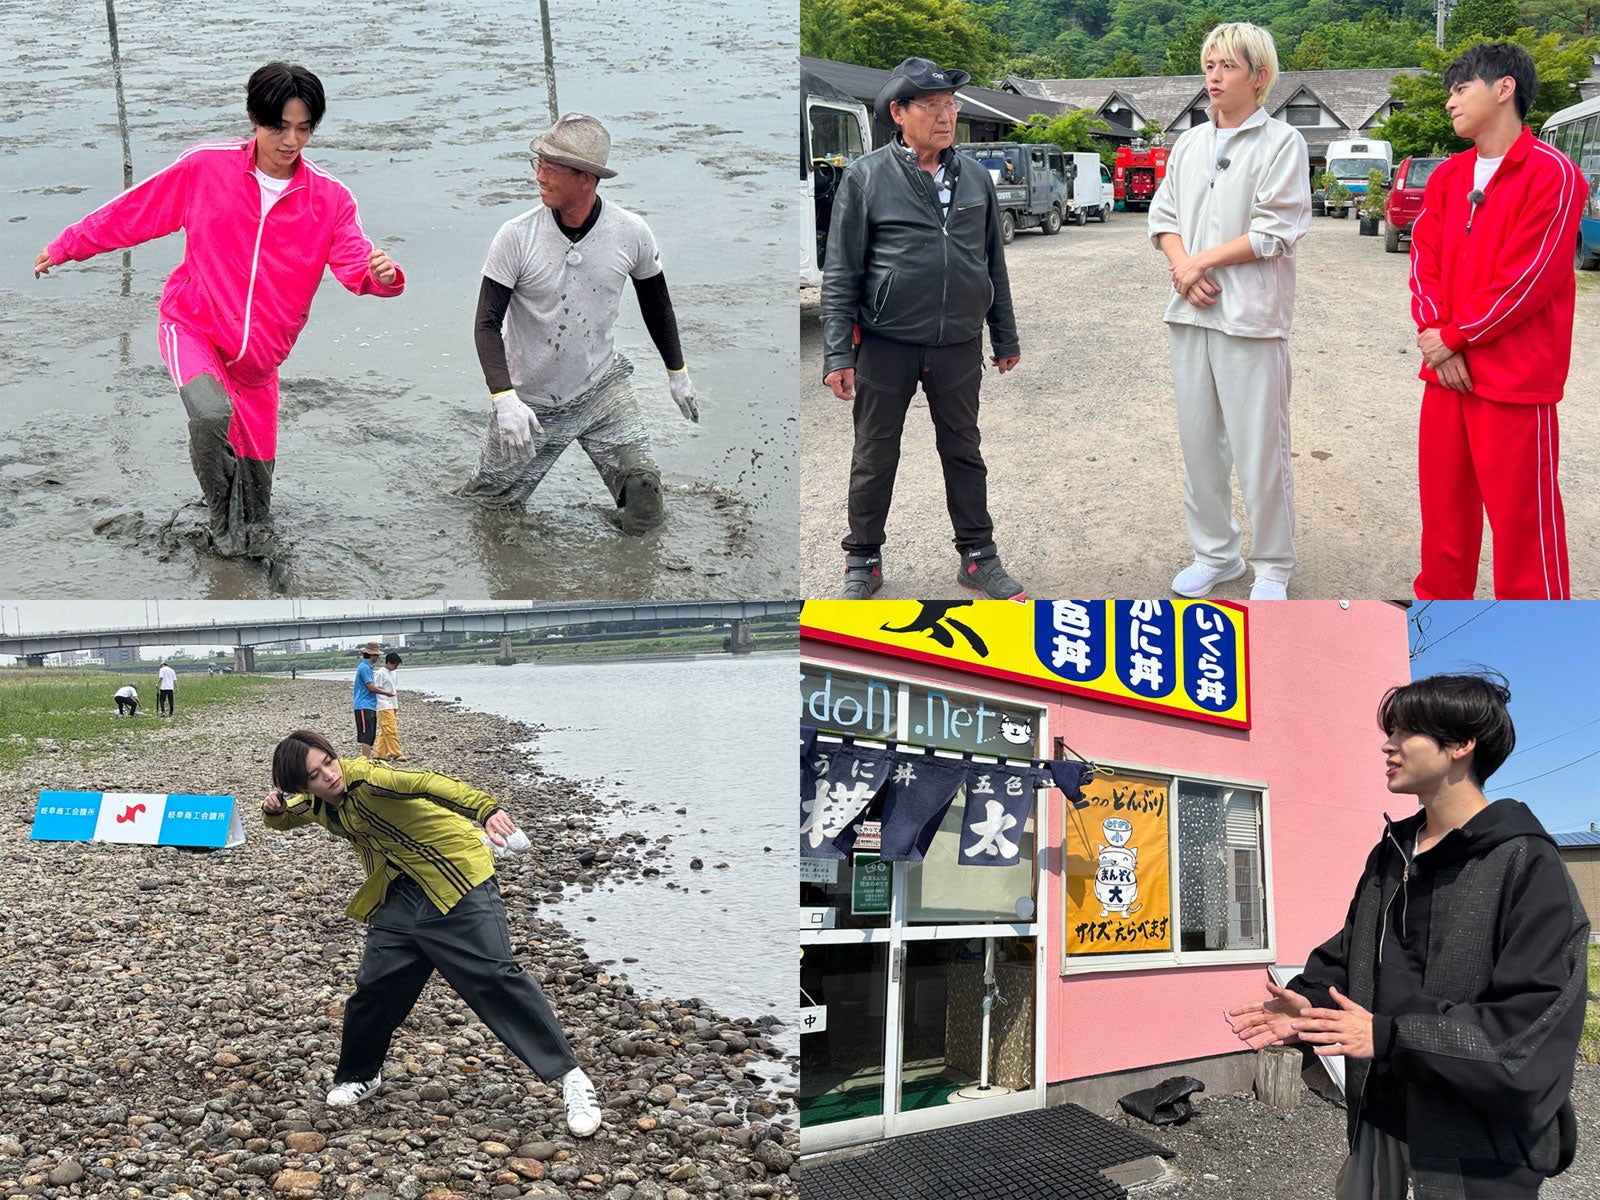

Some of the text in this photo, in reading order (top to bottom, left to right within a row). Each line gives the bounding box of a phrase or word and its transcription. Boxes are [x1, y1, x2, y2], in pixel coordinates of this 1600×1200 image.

[1051, 600, 1091, 674] 色丼
[1195, 607, 1226, 706] いくら丼
[40, 806, 96, 816] 岐阜商工会議所
[167, 810, 227, 821] 岐阜商工会議所
[963, 799, 1020, 859] 太
[1110, 831, 1124, 843] 小
[1101, 867, 1131, 883] まんぞく
[1108, 885, 1123, 903] 大
[804, 1014, 817, 1029] 中
